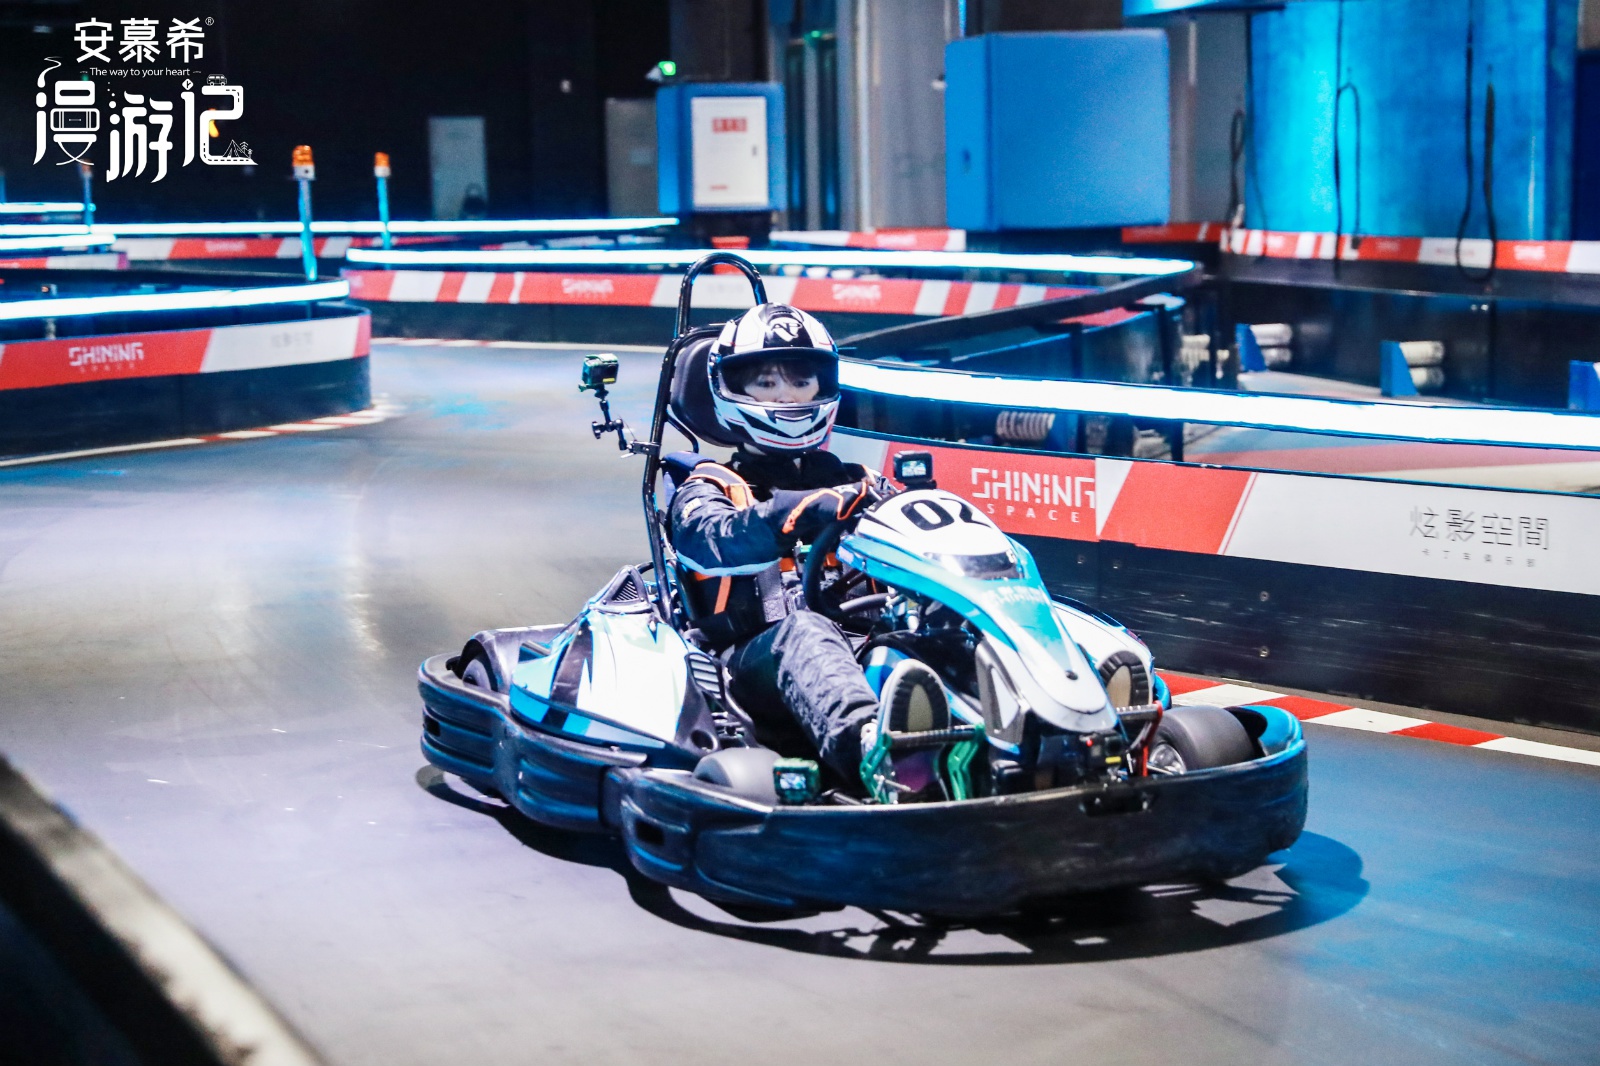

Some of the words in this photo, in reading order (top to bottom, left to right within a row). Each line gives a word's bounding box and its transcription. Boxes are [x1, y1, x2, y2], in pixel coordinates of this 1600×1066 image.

[69, 342, 144, 366] SHINING
[971, 467, 1096, 509] SHINING
[900, 497, 992, 531] 02
[986, 503, 1080, 523] SPACE
